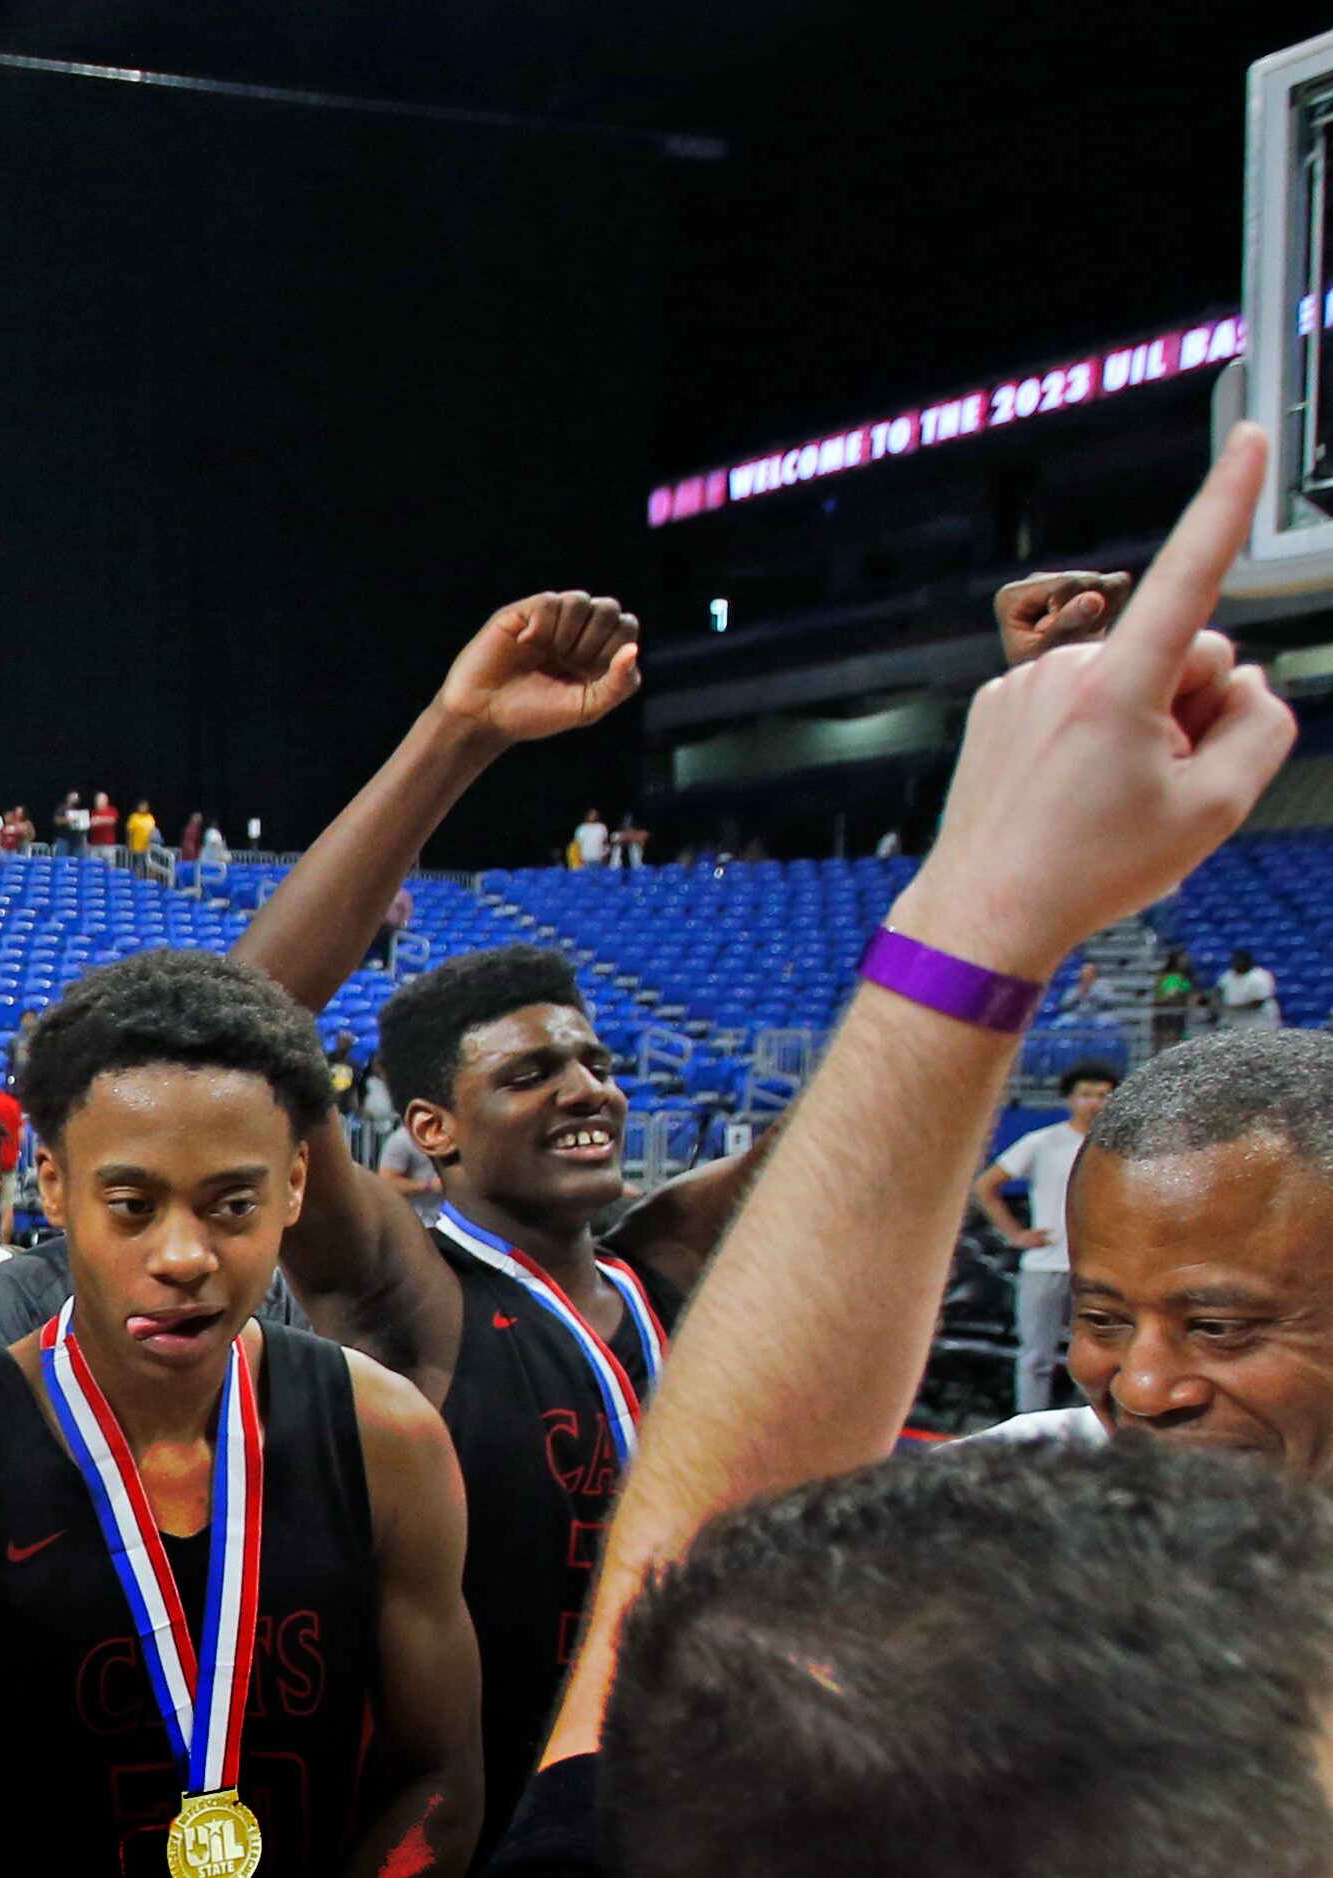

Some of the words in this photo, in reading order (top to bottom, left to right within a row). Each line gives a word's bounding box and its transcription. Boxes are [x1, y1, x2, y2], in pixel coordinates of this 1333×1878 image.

[729, 430, 864, 500] WELCOME
[870, 416, 912, 459] TO
[920, 394, 982, 445] THE
[990, 363, 1092, 426] 2023
[1102, 339, 1167, 393] UIL
